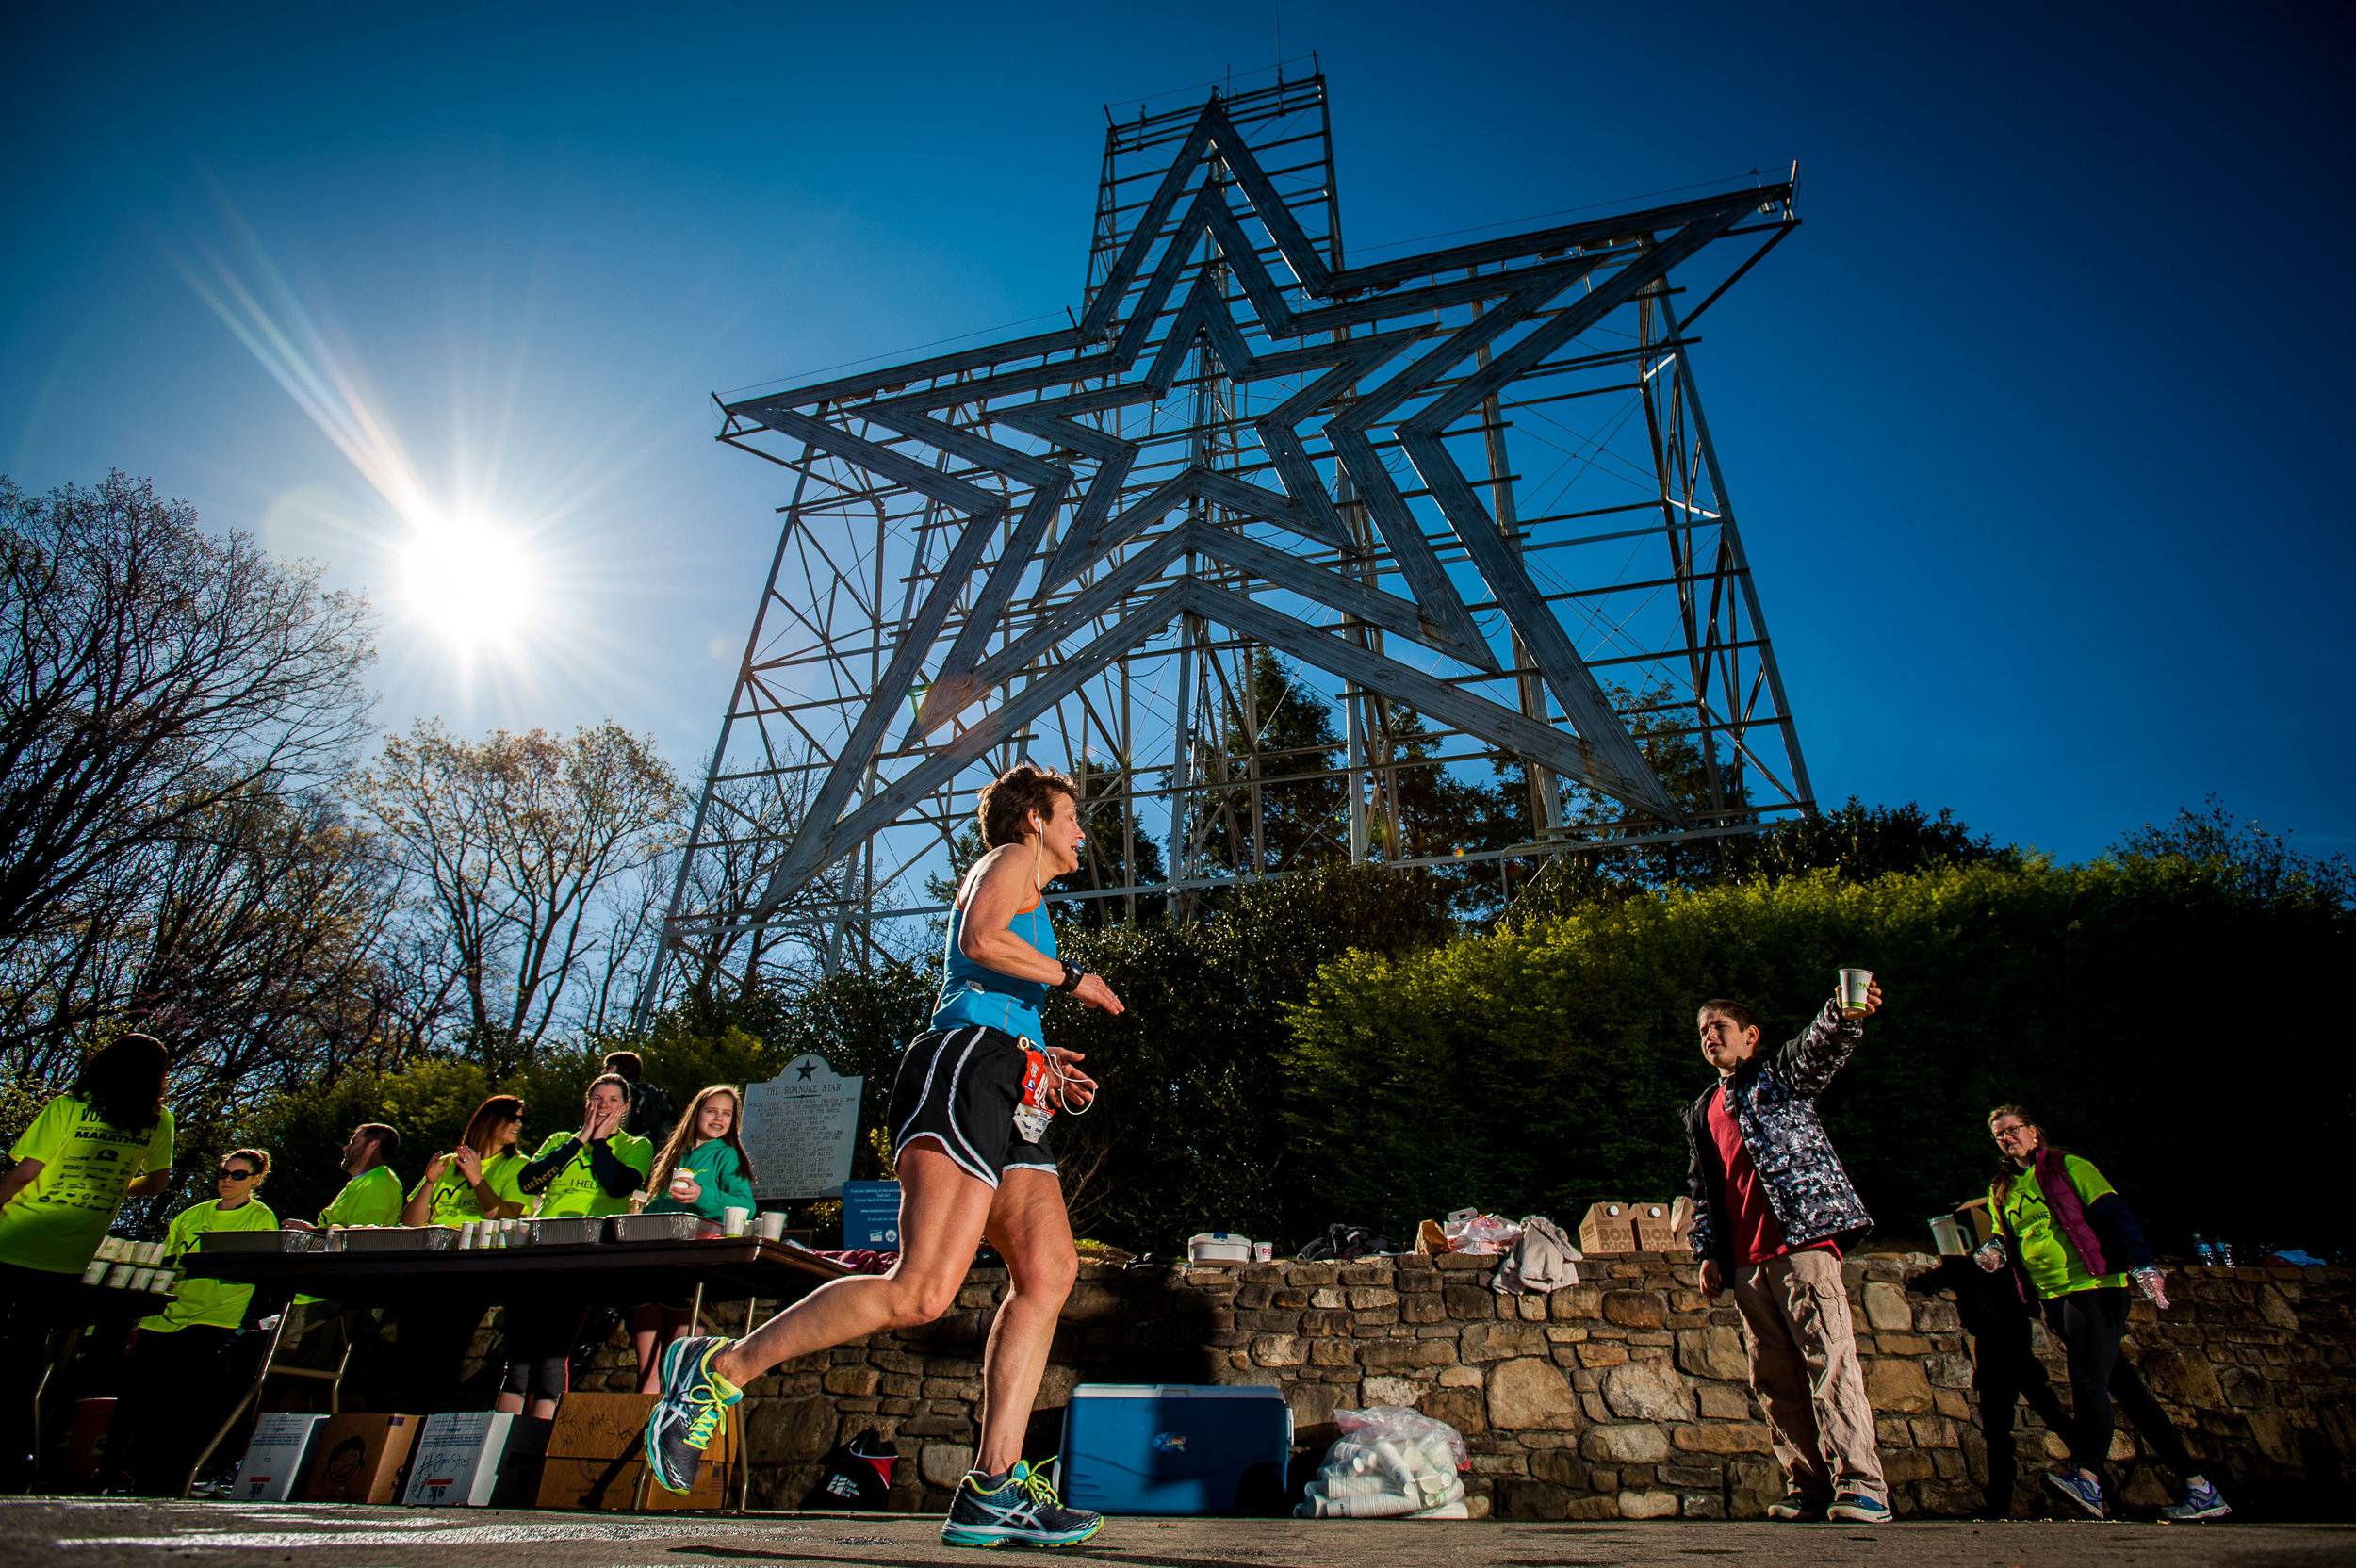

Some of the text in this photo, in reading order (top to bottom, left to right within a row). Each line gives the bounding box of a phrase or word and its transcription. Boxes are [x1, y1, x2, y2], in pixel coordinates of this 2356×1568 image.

[784, 1084, 818, 1094] ROANOKE
[822, 1083, 842, 1092] STAR
[524, 1166, 560, 1192] uthern
[1598, 1228, 1632, 1242] BOX
[1641, 1228, 1673, 1242] BOX
[1601, 1240, 1635, 1251] O'JOE
